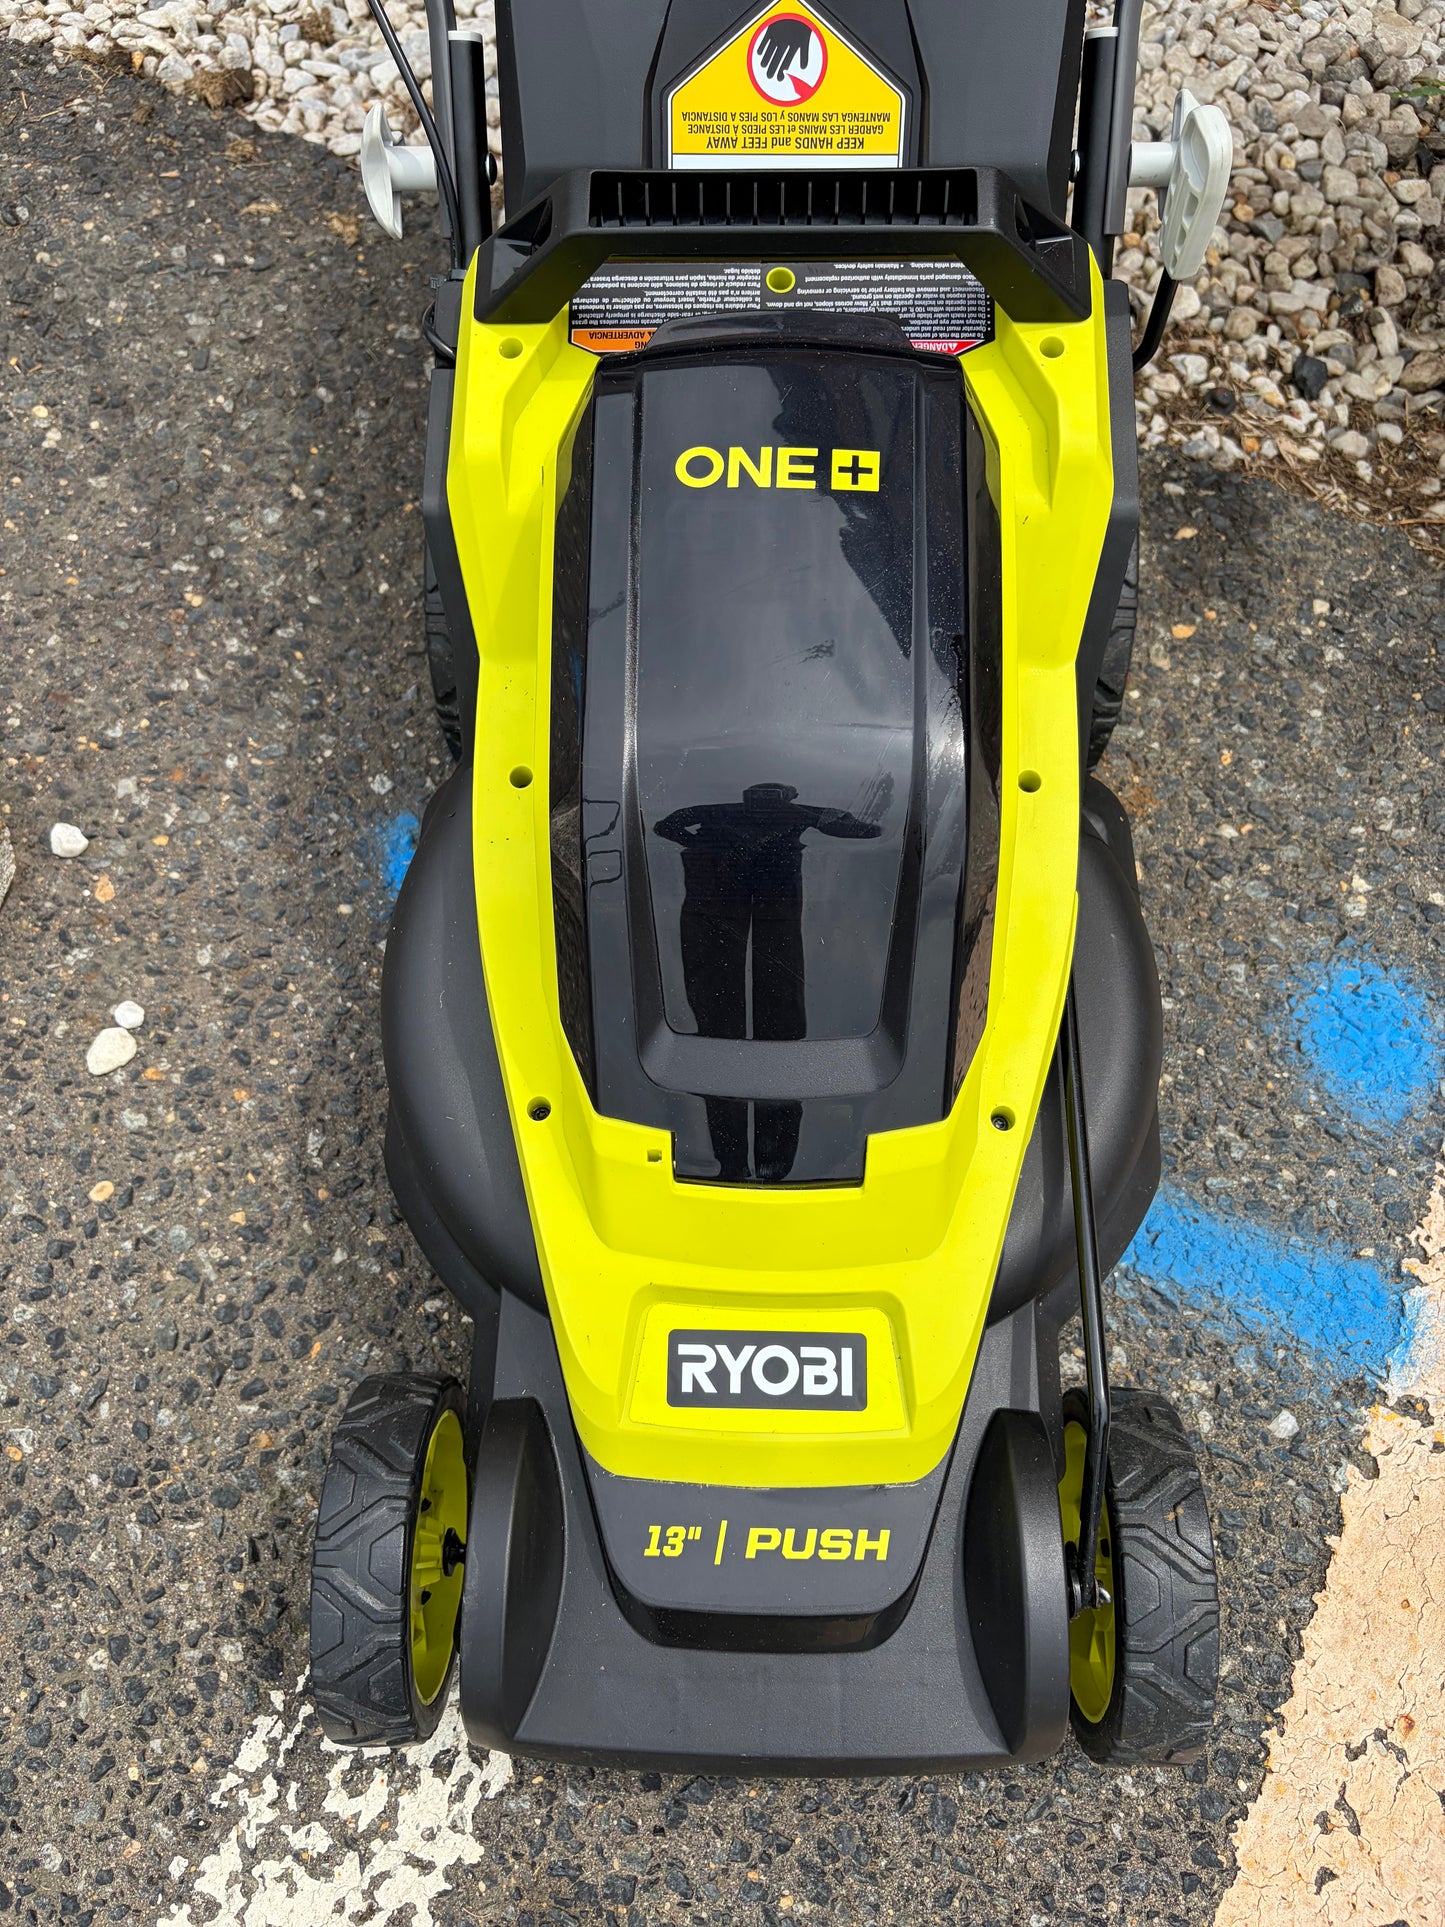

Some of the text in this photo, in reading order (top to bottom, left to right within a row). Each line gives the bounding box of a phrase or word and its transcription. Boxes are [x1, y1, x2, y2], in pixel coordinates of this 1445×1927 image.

[681, 110, 890, 122] MANTENGA LAS MANOS y LOS PIES A DISTANCIA
[687, 124, 884, 136] GARDER LES MAINS et LES PIEDS À DISTANCE
[706, 137, 864, 149] KEEP HANDS and FEET AWAY
[675, 446, 818, 489] ONE
[677, 1344, 853, 1396] RYOBI
[644, 1525, 891, 1561] 13" PUSH
